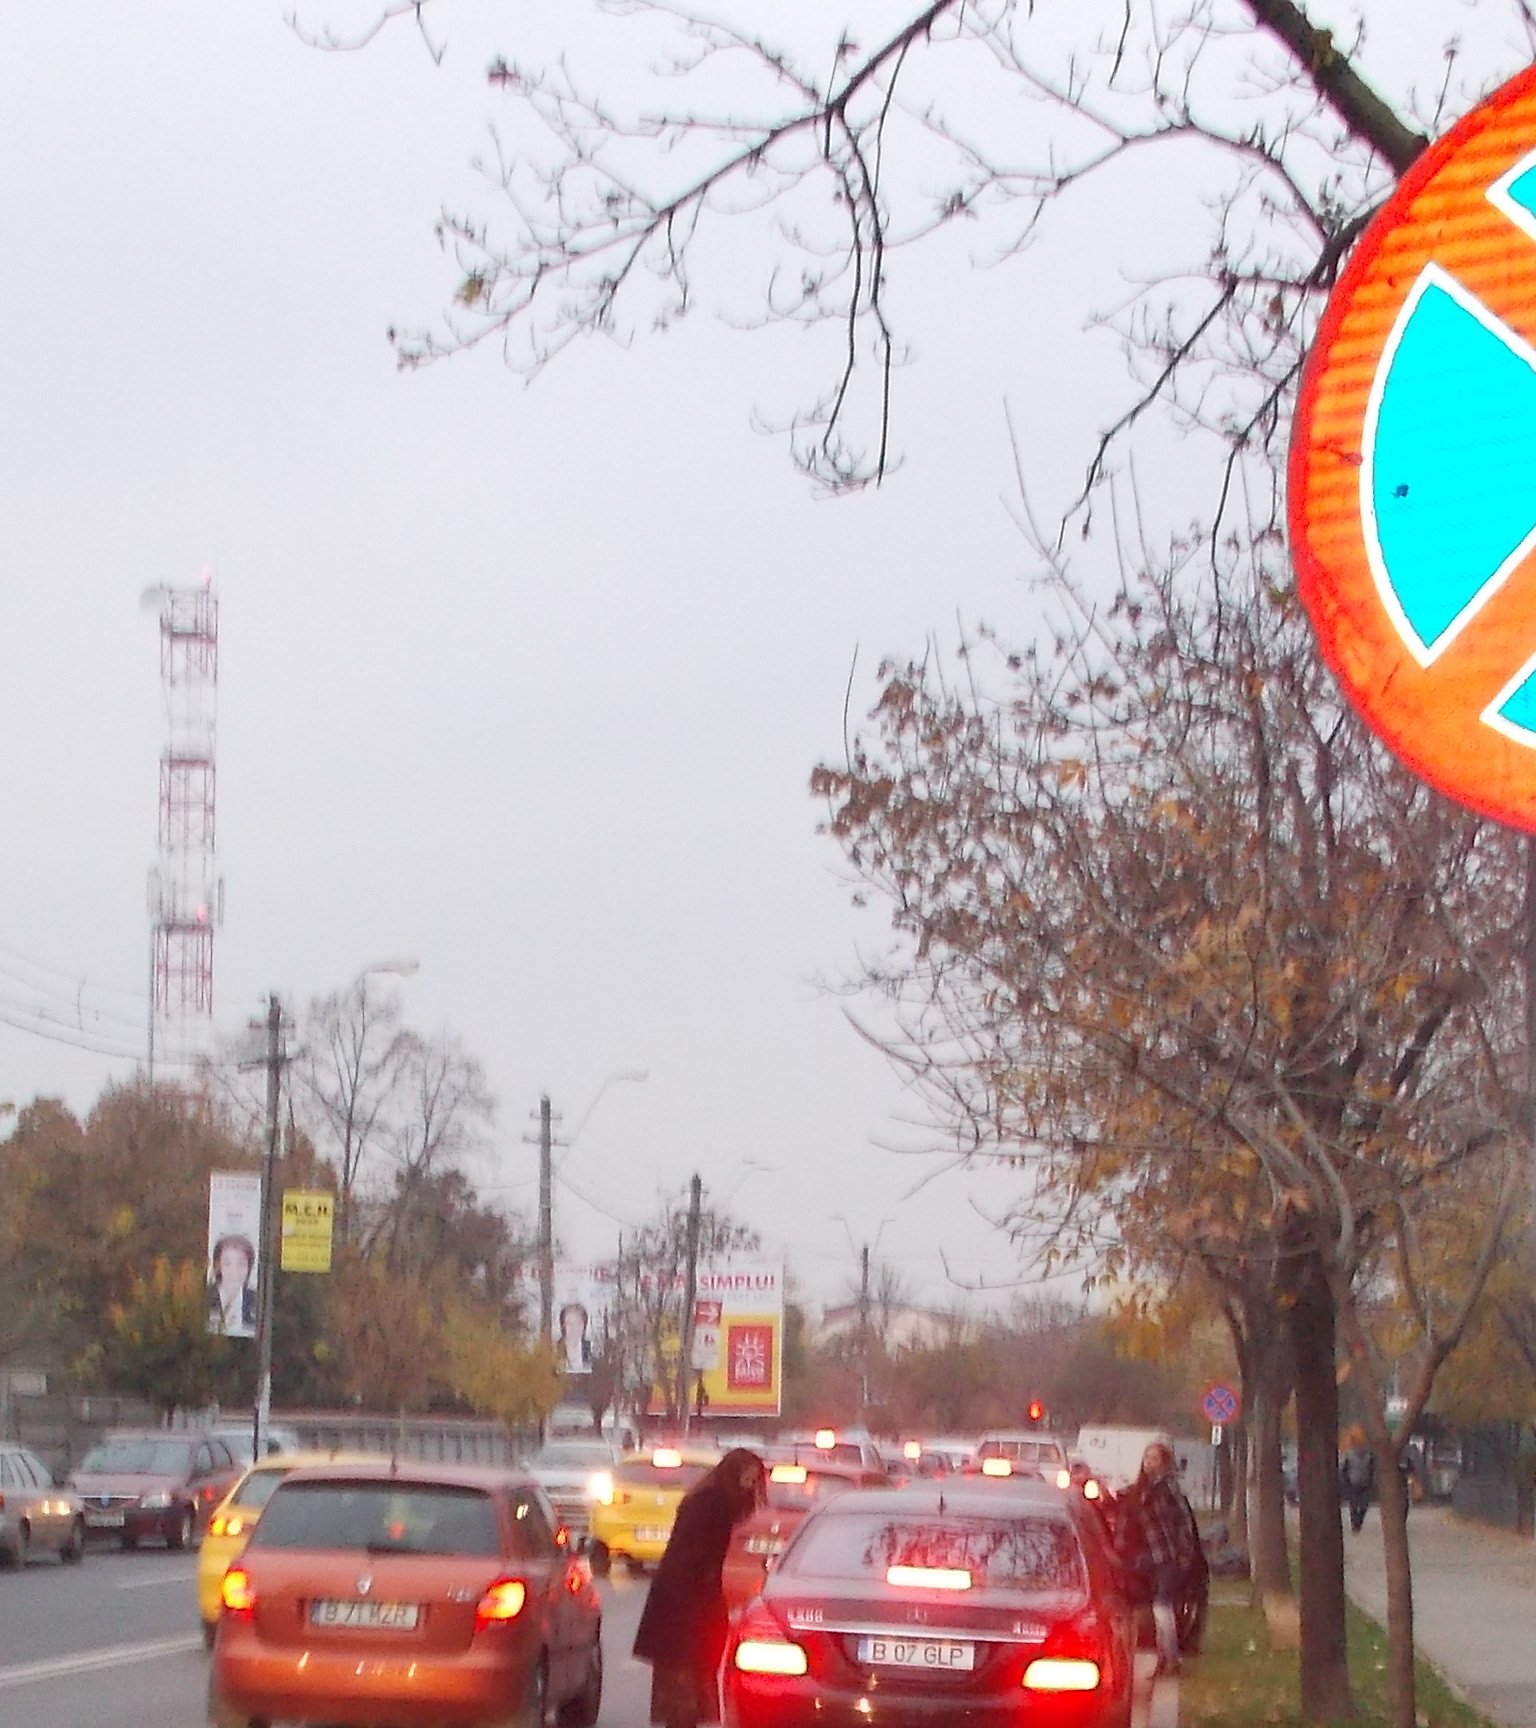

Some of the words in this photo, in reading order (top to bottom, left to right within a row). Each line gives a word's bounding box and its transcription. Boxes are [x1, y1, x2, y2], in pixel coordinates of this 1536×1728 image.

[872, 1643, 886, 1661] B
[894, 1644, 917, 1663] 07
[923, 1646, 964, 1667] GLP
